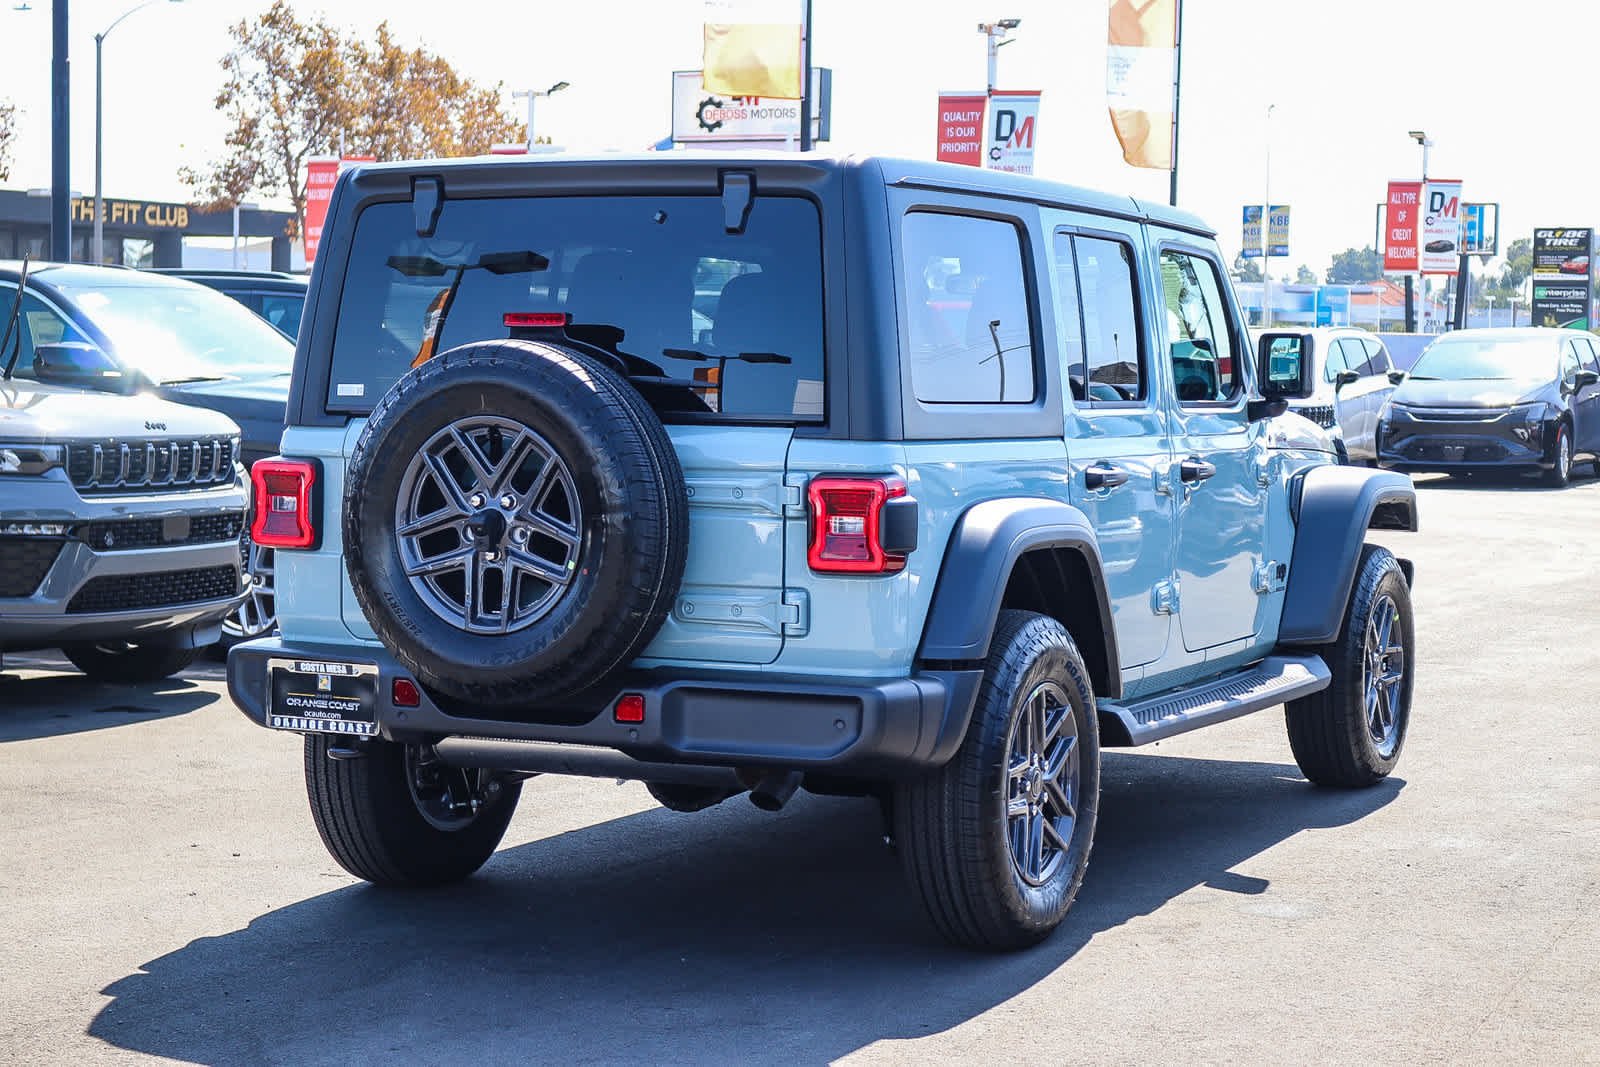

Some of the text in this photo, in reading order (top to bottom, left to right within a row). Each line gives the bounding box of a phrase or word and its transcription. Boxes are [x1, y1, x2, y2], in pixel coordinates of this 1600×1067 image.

[704, 107, 797, 121] DEBOSS MOTORS
[943, 112, 981, 122] QUALITY
[947, 127, 976, 137] IS OUR
[941, 142, 980, 153] PRIORITY
[1391, 192, 1416, 204] ALL TYPE
[111, 201, 141, 225] FIT
[144, 204, 188, 228] CLUB
[1398, 211, 1407, 222] OF
[1392, 229, 1412, 241] CREDIT
[1545, 238, 1580, 246] TIRE
[1388, 247, 1416, 259] WELCOME
[144, 421, 167, 431] Jeep
[300, 662, 348, 675] COSTA MESA
[286, 697, 361, 711] ORANGE COAST
[304, 710, 341, 719] ocauto.com
[273, 717, 373, 734] ORANGE COAST
